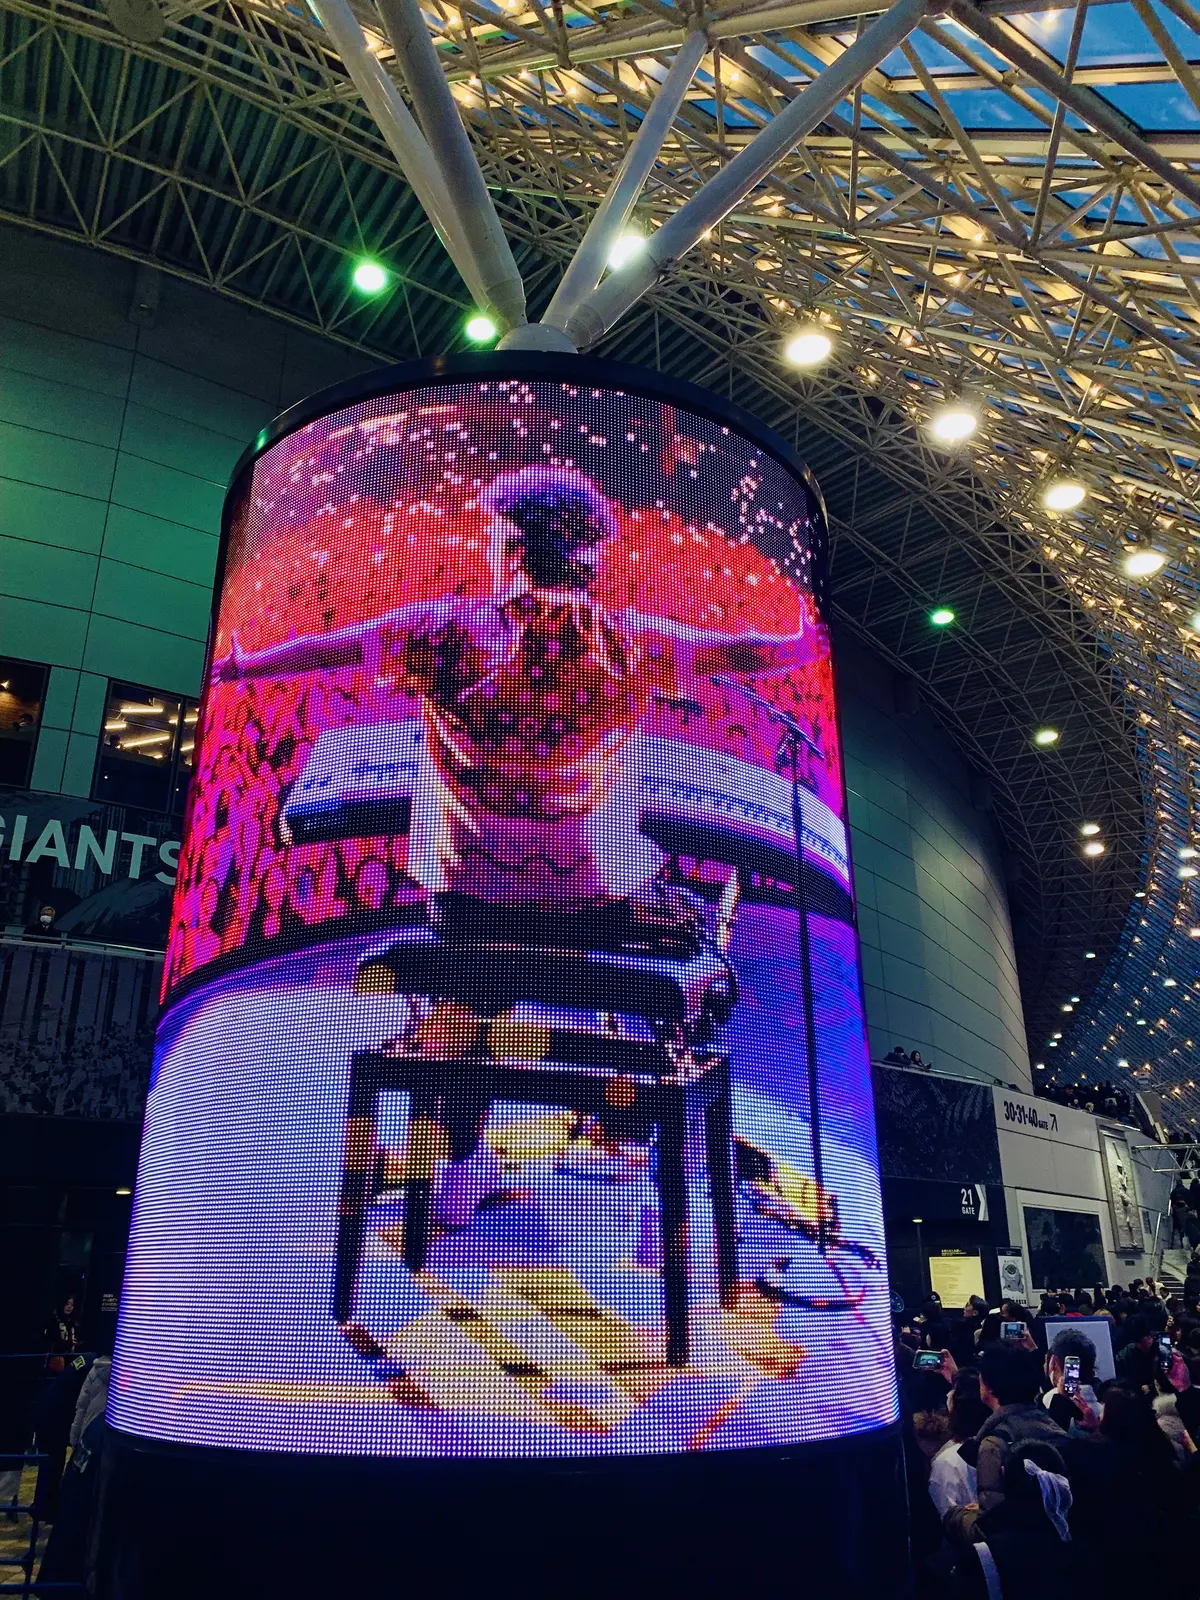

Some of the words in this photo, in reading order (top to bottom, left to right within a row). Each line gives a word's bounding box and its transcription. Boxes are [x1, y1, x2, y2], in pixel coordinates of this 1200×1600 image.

[0, 814, 182, 885] IANTS
[961, 1188, 973, 1205] 21
[961, 1206, 976, 1215] GATE
